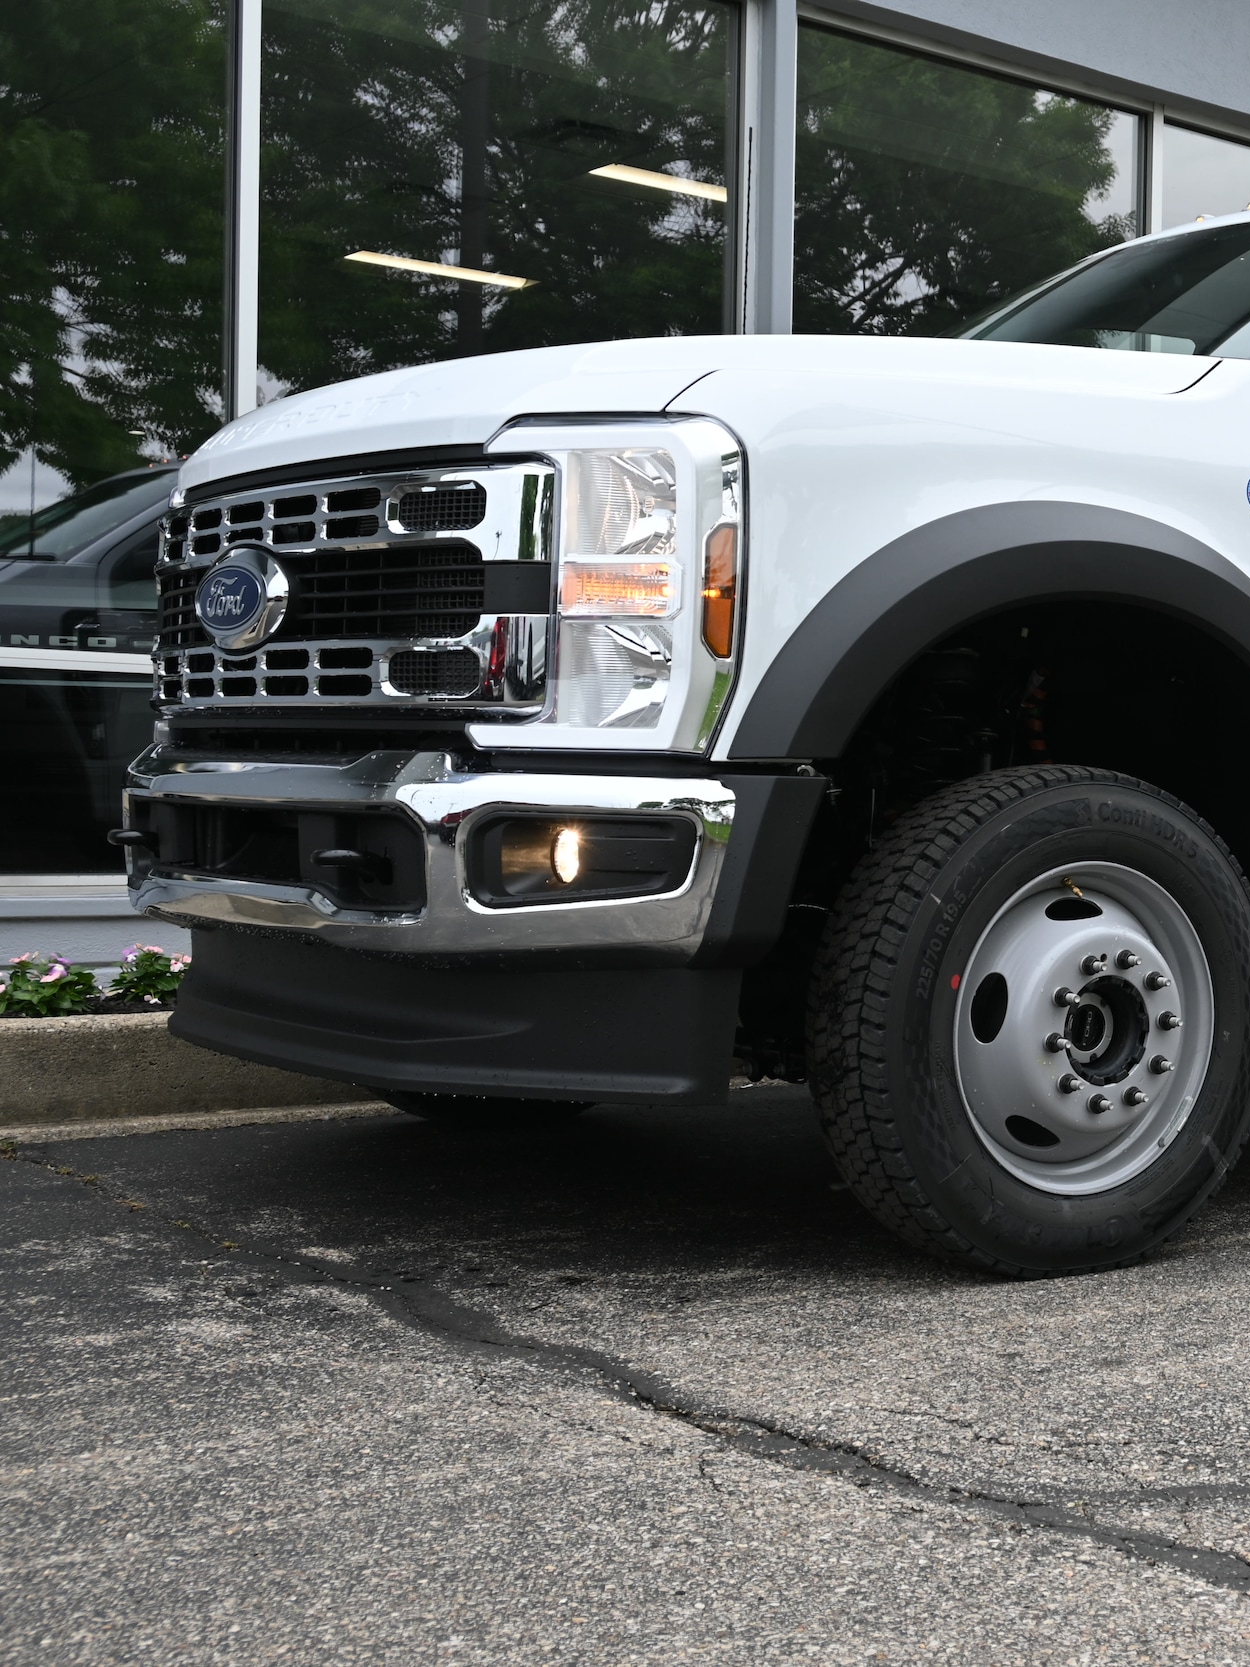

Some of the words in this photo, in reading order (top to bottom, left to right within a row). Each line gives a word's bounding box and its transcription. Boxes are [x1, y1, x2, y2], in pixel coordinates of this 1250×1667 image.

[206, 576, 247, 618] Ford
[0, 634, 117, 648] NCO
[915, 938, 943, 1000] 225/70
[936, 923, 950, 937] R
